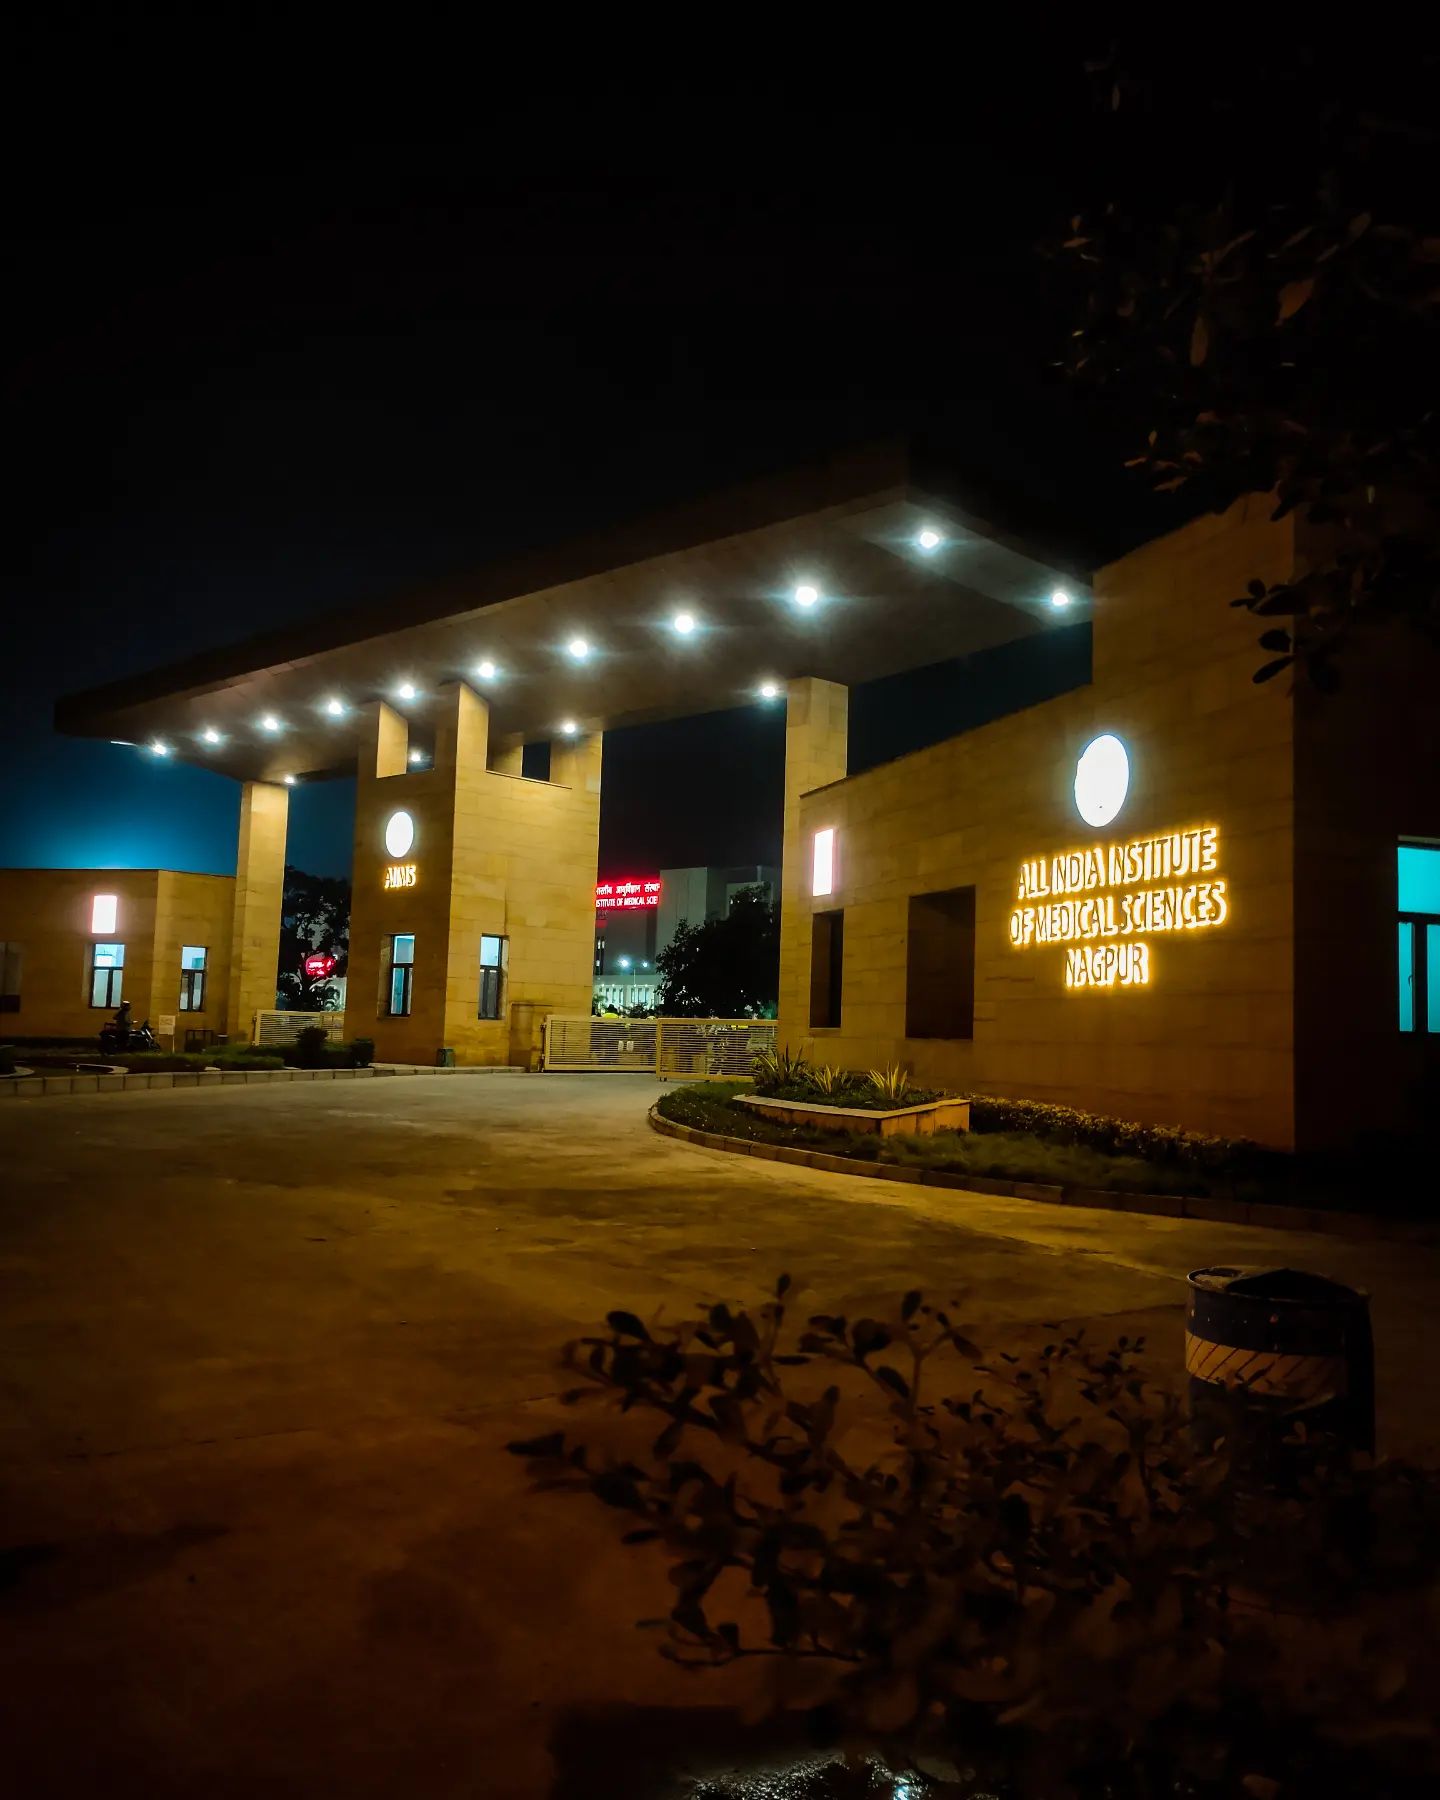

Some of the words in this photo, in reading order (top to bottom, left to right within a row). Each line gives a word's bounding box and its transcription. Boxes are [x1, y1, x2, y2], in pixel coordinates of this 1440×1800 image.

[384, 864, 417, 889] AIIMS
[1017, 859, 1050, 899] ALL
[1050, 848, 1106, 896] INDIA
[1107, 827, 1217, 886] INSTITUTE
[616, 897, 624, 906] OF
[624, 896, 645, 906] MEDICAL
[1010, 908, 1034, 945] OF
[1035, 896, 1119, 943] MEDICAL
[1119, 881, 1228, 935] SCIENCES
[1065, 943, 1149, 988] NAGPUR
